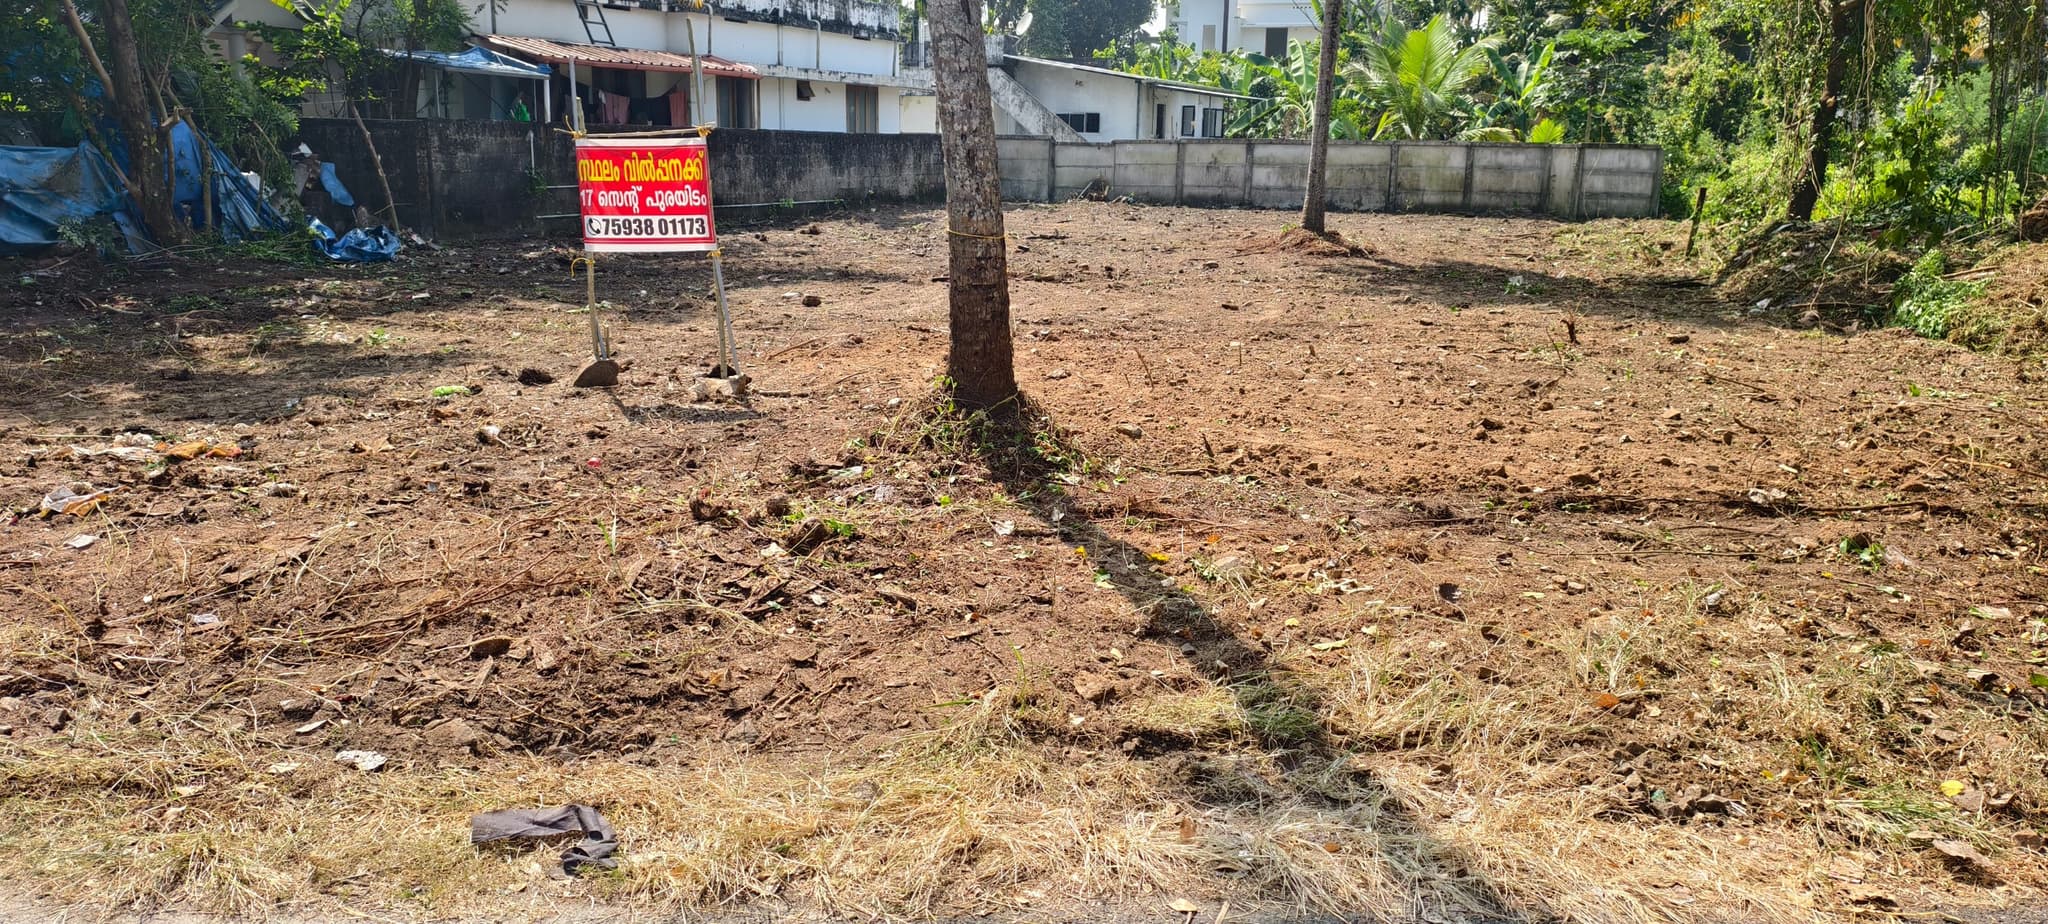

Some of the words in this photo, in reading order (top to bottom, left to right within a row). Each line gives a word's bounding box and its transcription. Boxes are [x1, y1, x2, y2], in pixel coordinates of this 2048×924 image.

[578, 159, 620, 182] സ്ഥലം
[580, 189, 593, 207] 17
[646, 184, 707, 212] പുരയിടം
[602, 218, 654, 237] 75938
[658, 217, 706, 236] 01173
